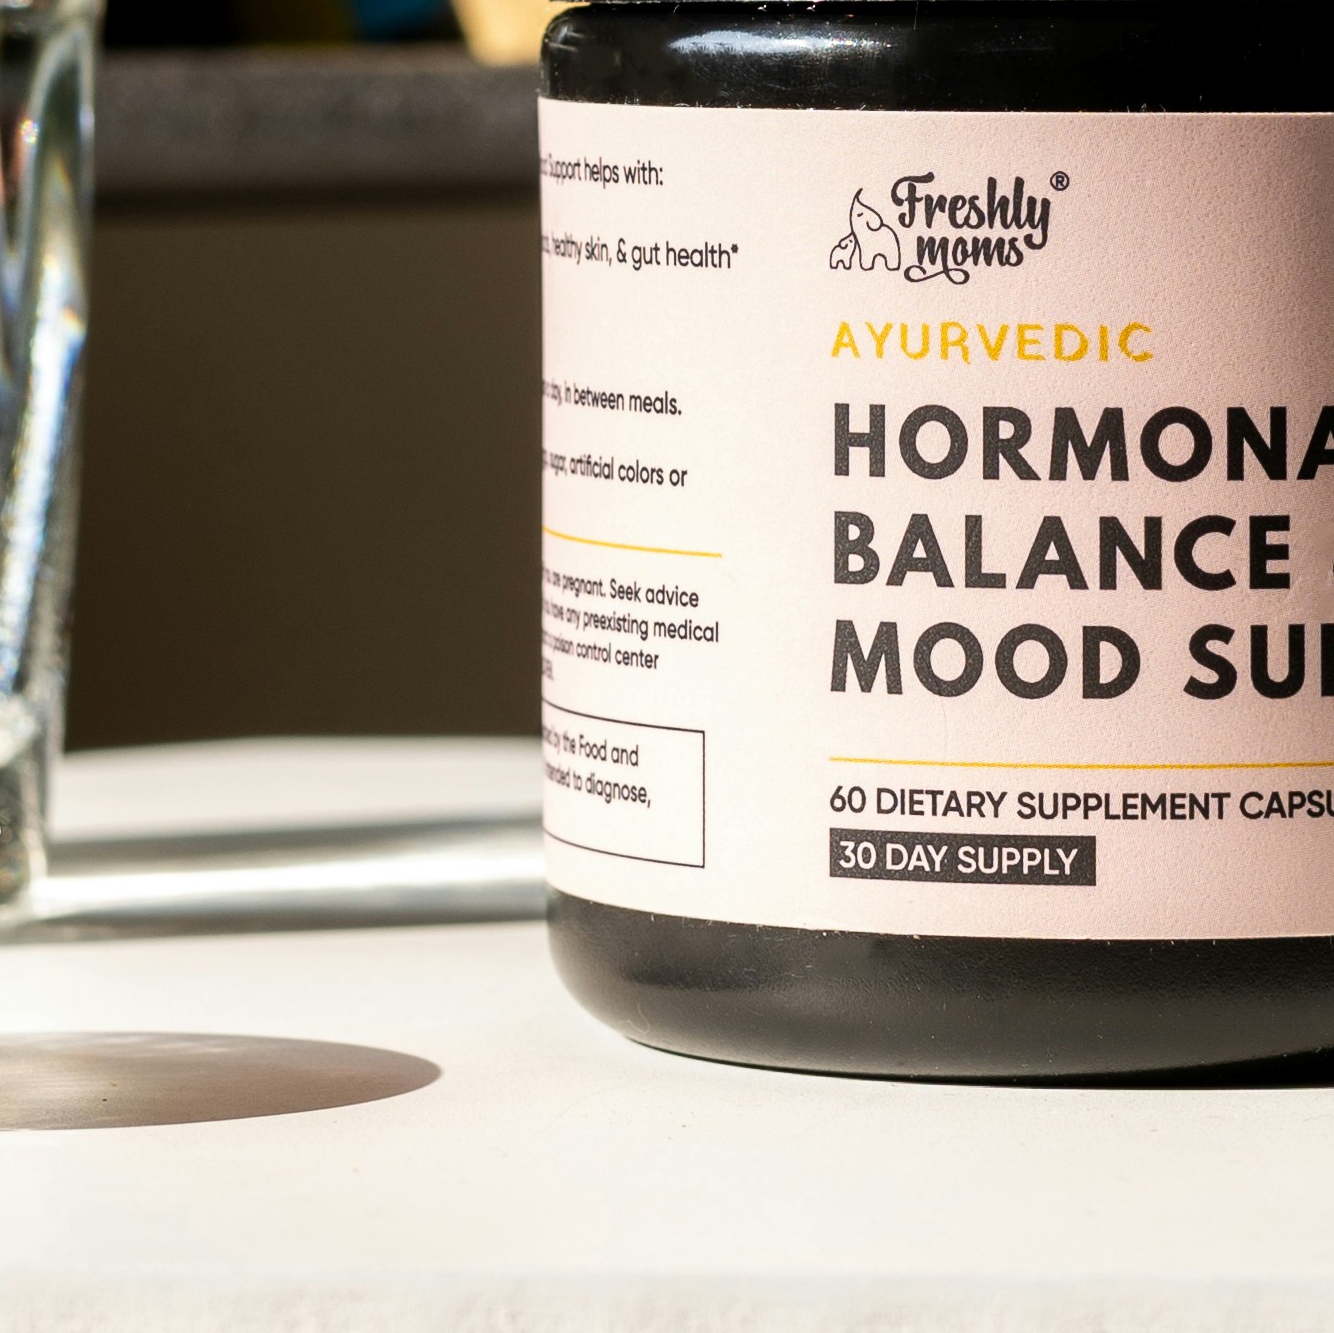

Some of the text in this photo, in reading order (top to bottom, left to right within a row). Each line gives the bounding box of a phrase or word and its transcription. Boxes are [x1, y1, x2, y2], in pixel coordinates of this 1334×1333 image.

[584, 156, 620, 190] helps
[623, 159, 664, 187] with:
[585, 235, 612, 268] skin,
[616, 237, 628, 264] &
[631, 242, 661, 271] gut
[903, 232, 1026, 285] moms
[830, 320, 1154, 364] AYURVEDIC
[564, 380, 572, 404] in
[573, 383, 625, 412] between
[628, 390, 683, 416] meals.
[569, 454, 614, 481] artificial
[617, 459, 665, 486] colors
[668, 468, 688, 488] or
[832, 510, 1291, 591] BALANCE
[562, 573, 607, 599] pregnant.
[609, 577, 642, 604] Seek
[645, 585, 700, 609] advice
[566, 607, 581, 630] any
[582, 611, 649, 642] preexisting
[653, 619, 719, 643] medical
[576, 641, 612, 664] control
[614, 648, 660, 670] center
[829, 618, 1142, 700] MOOD
[562, 730, 576, 755] the
[578, 733, 607, 762] Food
[610, 743, 640, 768] and
[572, 771, 583, 792] to
[585, 772, 652, 809] diagnose,
[829, 785, 867, 815] 60
[875, 788, 1007, 819] DIETARY
[1016, 790, 1232, 821] SUPPLEMENT
[837, 840, 1080, 876] 30 DAY SUPPLY
